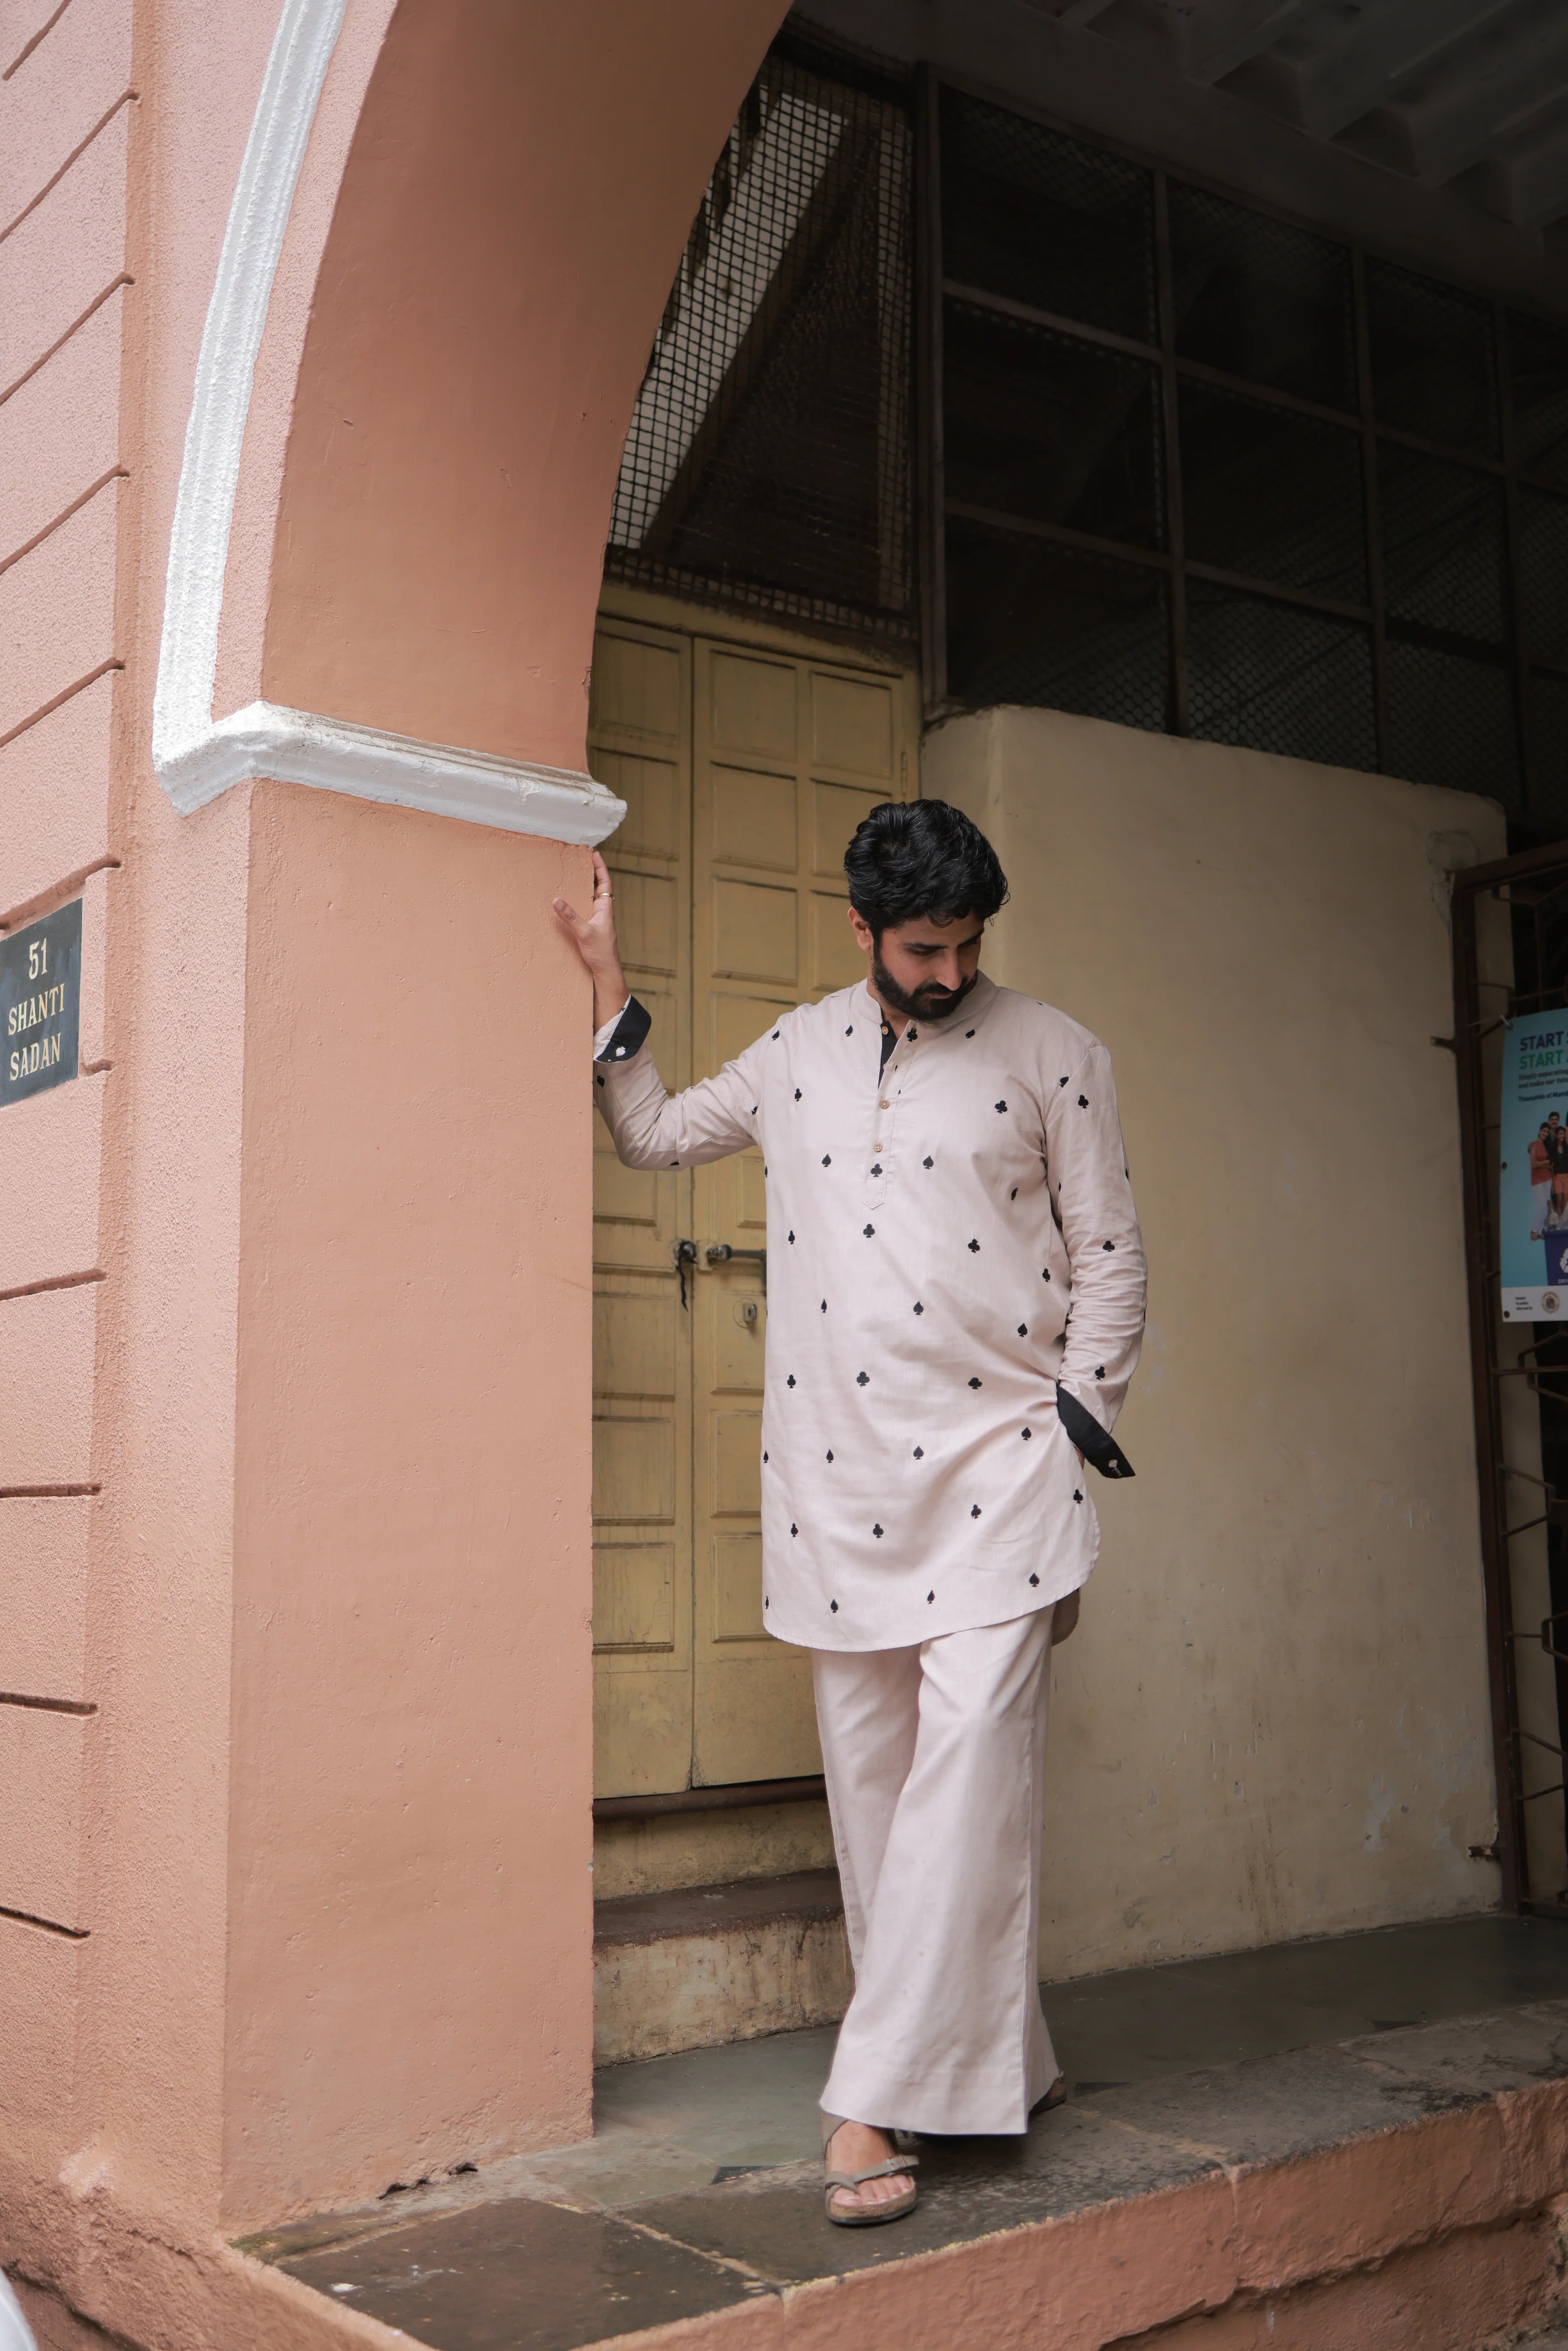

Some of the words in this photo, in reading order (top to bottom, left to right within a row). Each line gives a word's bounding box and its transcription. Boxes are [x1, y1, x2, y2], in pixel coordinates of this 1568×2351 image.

[28, 937, 48, 980] 51
[7, 983, 65, 1036] SHANTI
[9, 1033, 61, 1081] SADAN
[1519, 1050, 1564, 1069] START
[1520, 1031, 1565, 1052] START
